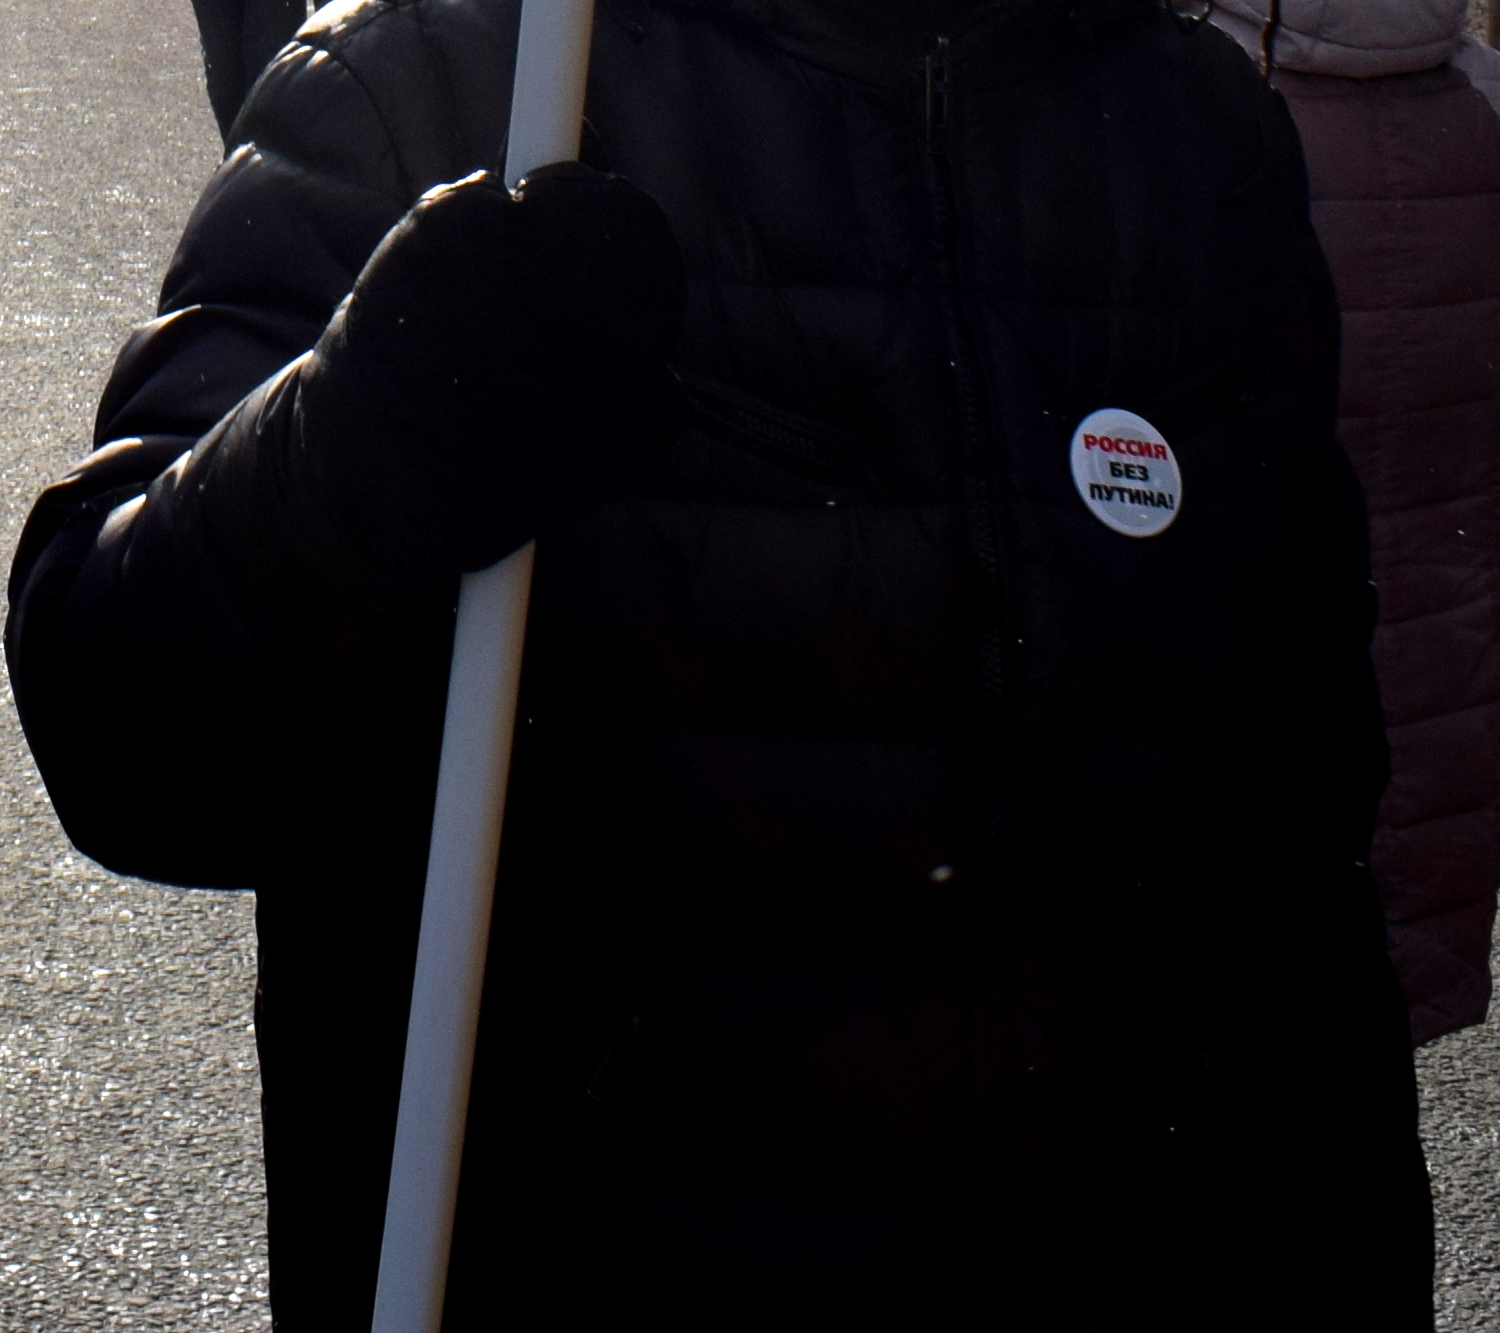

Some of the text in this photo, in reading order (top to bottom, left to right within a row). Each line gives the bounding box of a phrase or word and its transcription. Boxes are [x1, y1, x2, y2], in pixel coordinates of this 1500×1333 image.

[1083, 433, 1168, 461] РОССИЯ
[1109, 461, 1149, 481] БЕЗ
[1089, 483, 1174, 511] ПУТИНА!
